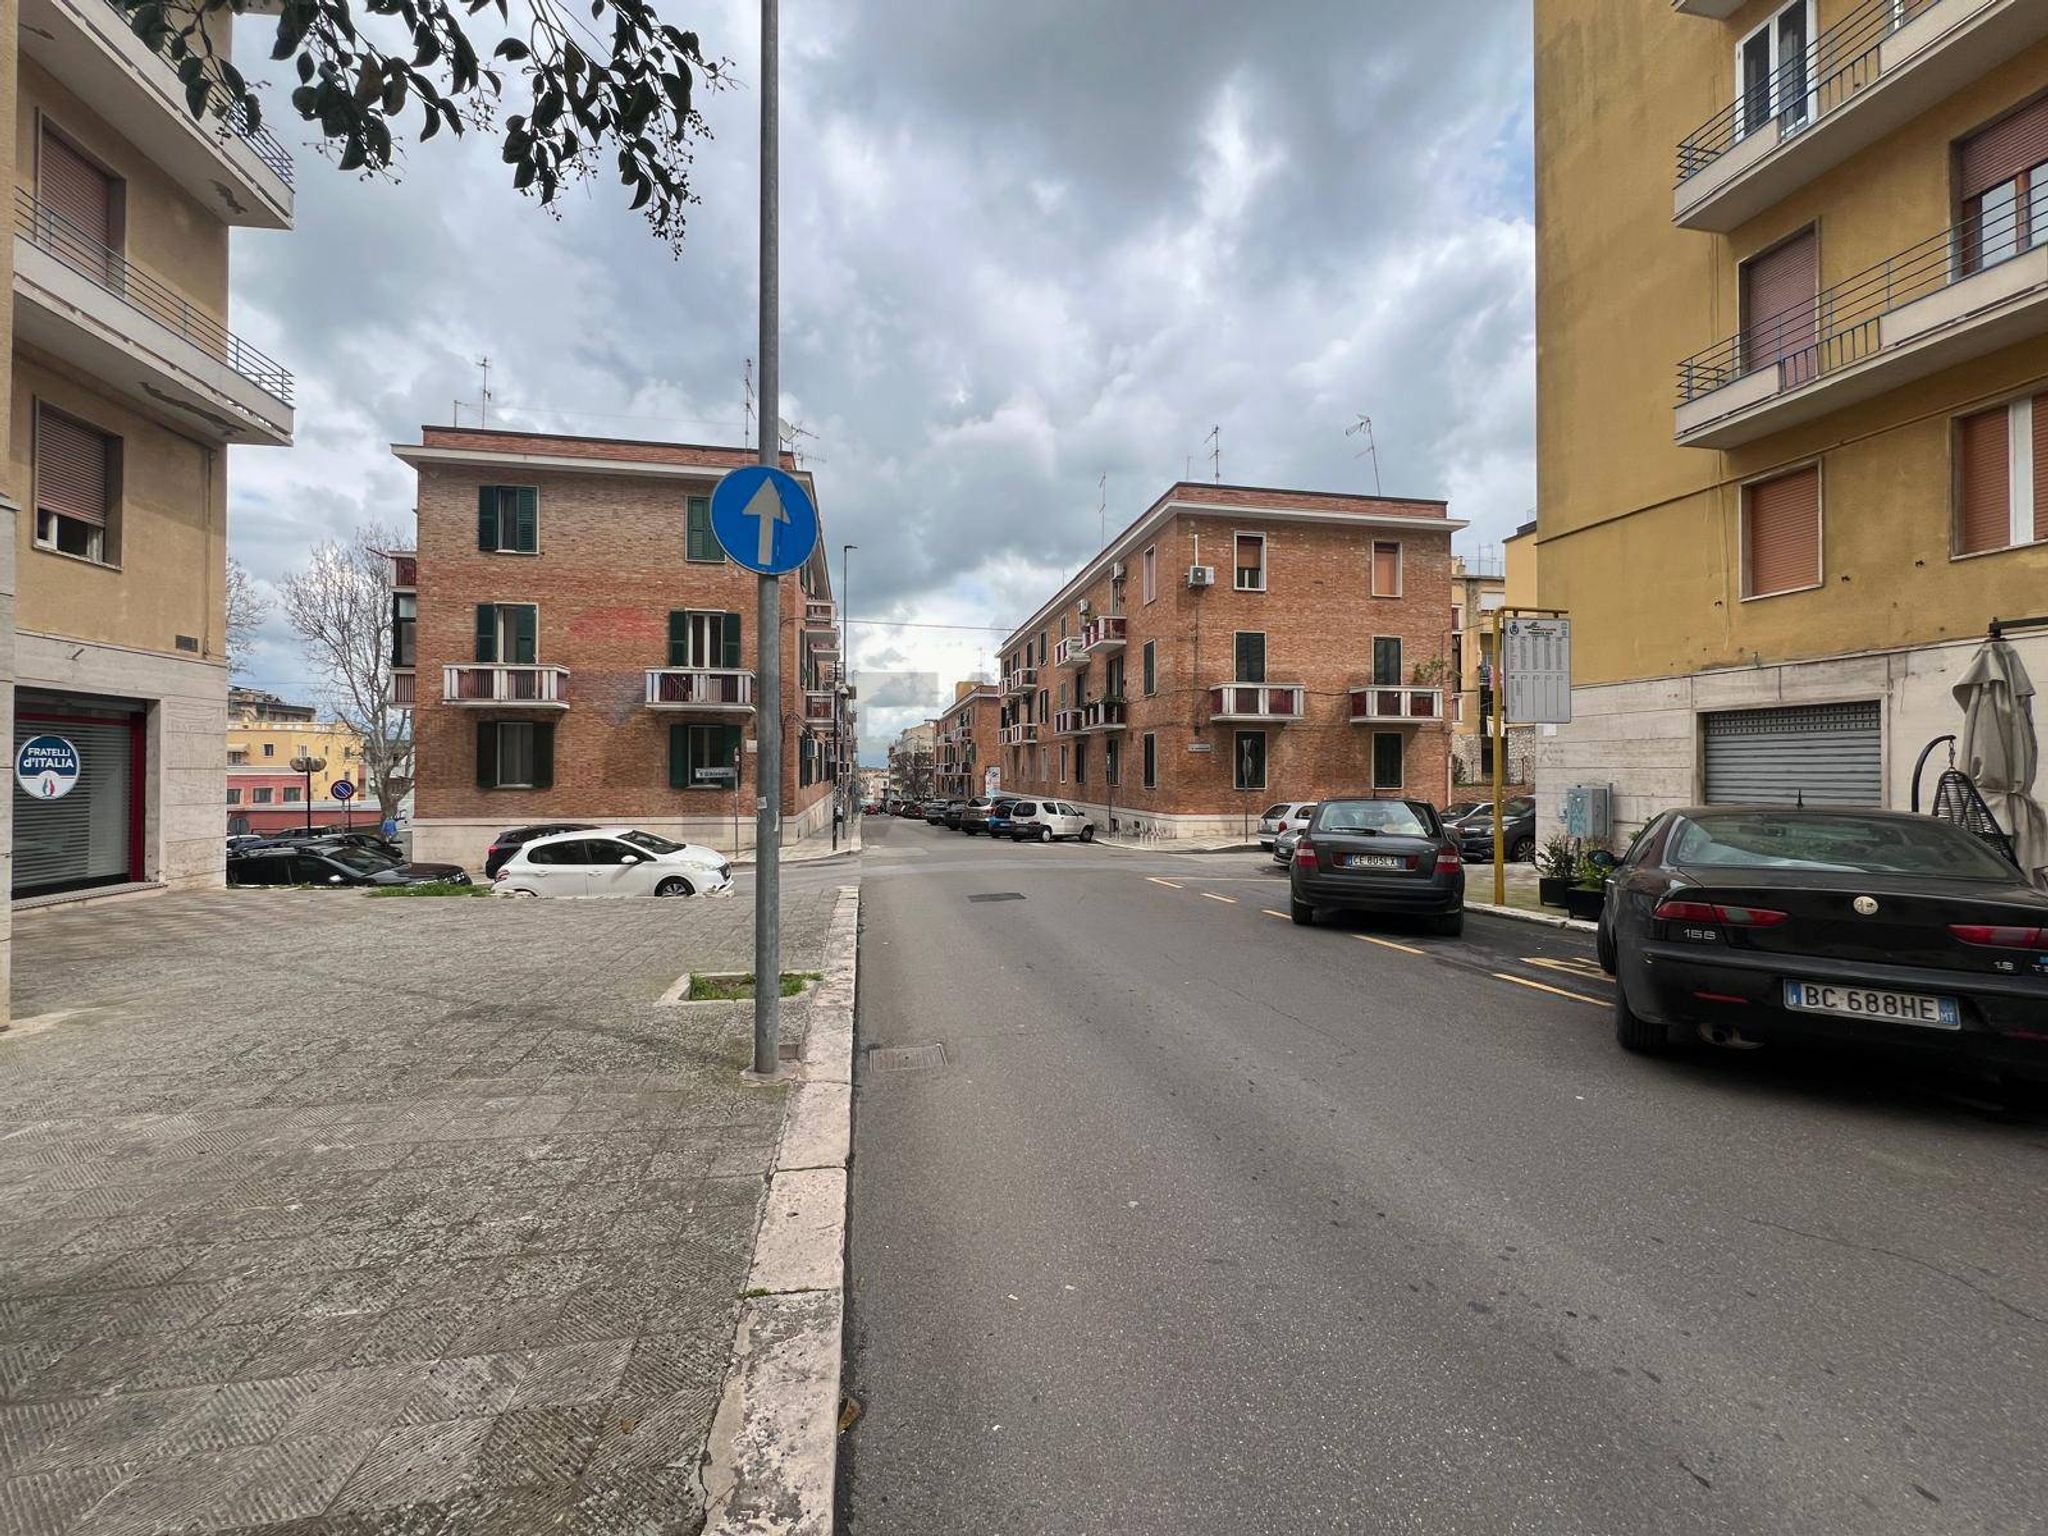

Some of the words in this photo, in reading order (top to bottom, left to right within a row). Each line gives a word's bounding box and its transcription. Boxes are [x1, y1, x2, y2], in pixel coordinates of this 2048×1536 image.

[28, 747, 71, 757] FRATELLI
[23, 757, 75, 768] d'ITALIA
[1683, 929, 1717, 940] 156
[1805, 986, 1837, 1008] BC
[1847, 990, 1937, 1021] 688HE
